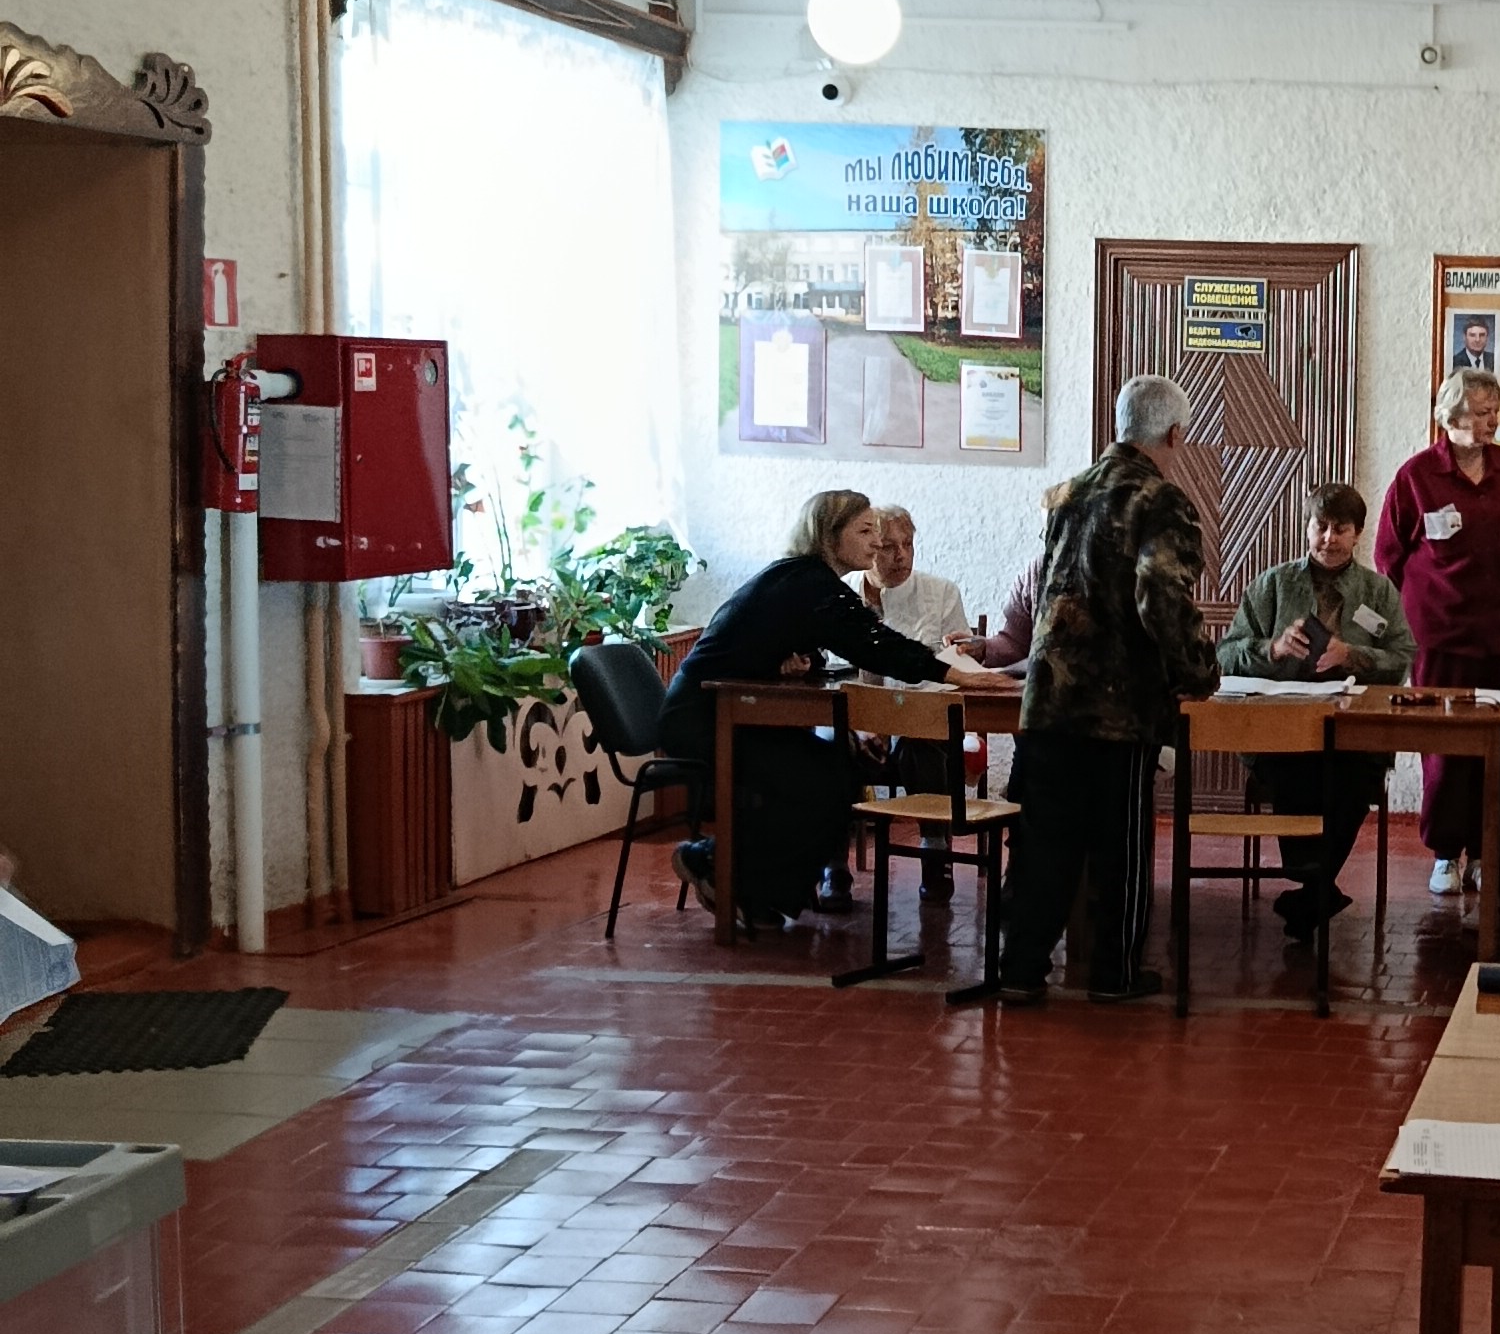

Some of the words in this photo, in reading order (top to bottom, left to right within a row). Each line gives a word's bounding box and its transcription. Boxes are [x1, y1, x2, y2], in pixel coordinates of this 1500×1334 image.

[891, 143, 969, 183] любим
[847, 193, 918, 214] наша
[928, 195, 1027, 218] школа!
[1194, 282, 1258, 294] СЛУЖЕБНОЕ
[1192, 293, 1259, 306] ПОМЕЩЕНИЕ
